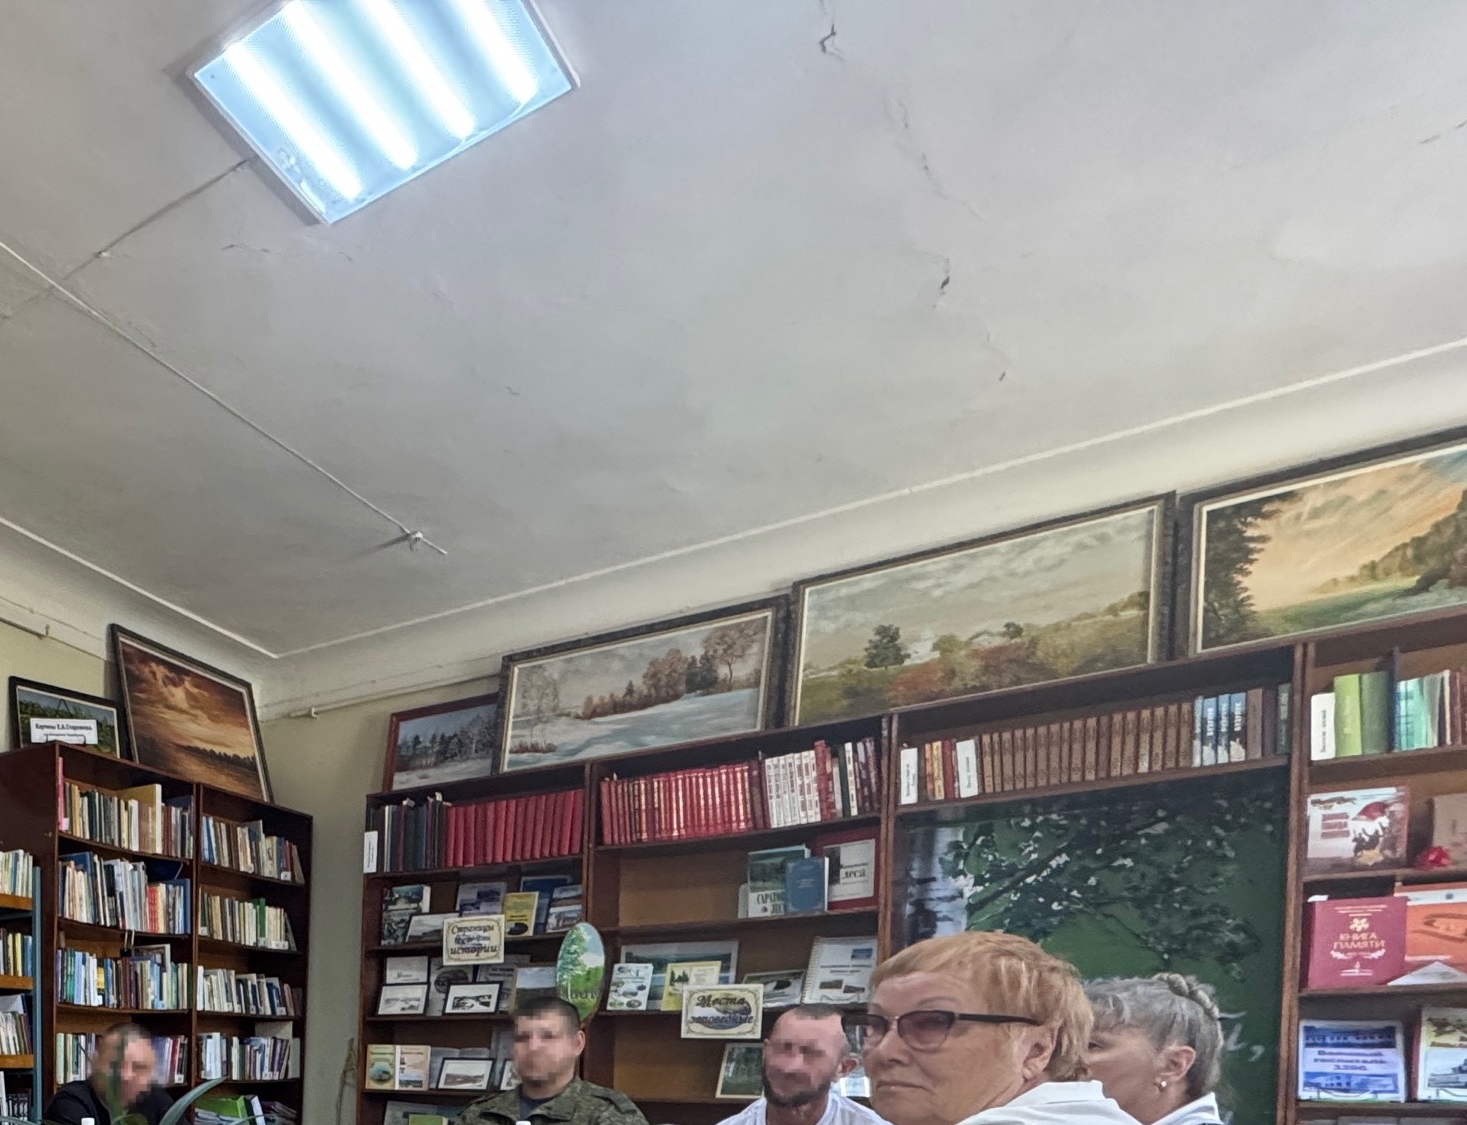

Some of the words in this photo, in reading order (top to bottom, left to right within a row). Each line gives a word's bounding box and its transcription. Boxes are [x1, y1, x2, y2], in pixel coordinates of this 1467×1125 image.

[1338, 932, 1378, 941] КНИГА
[1334, 939, 1386, 950] ПАМЯТИ
[450, 945, 498, 957] истории
[696, 994, 747, 1008] Места
